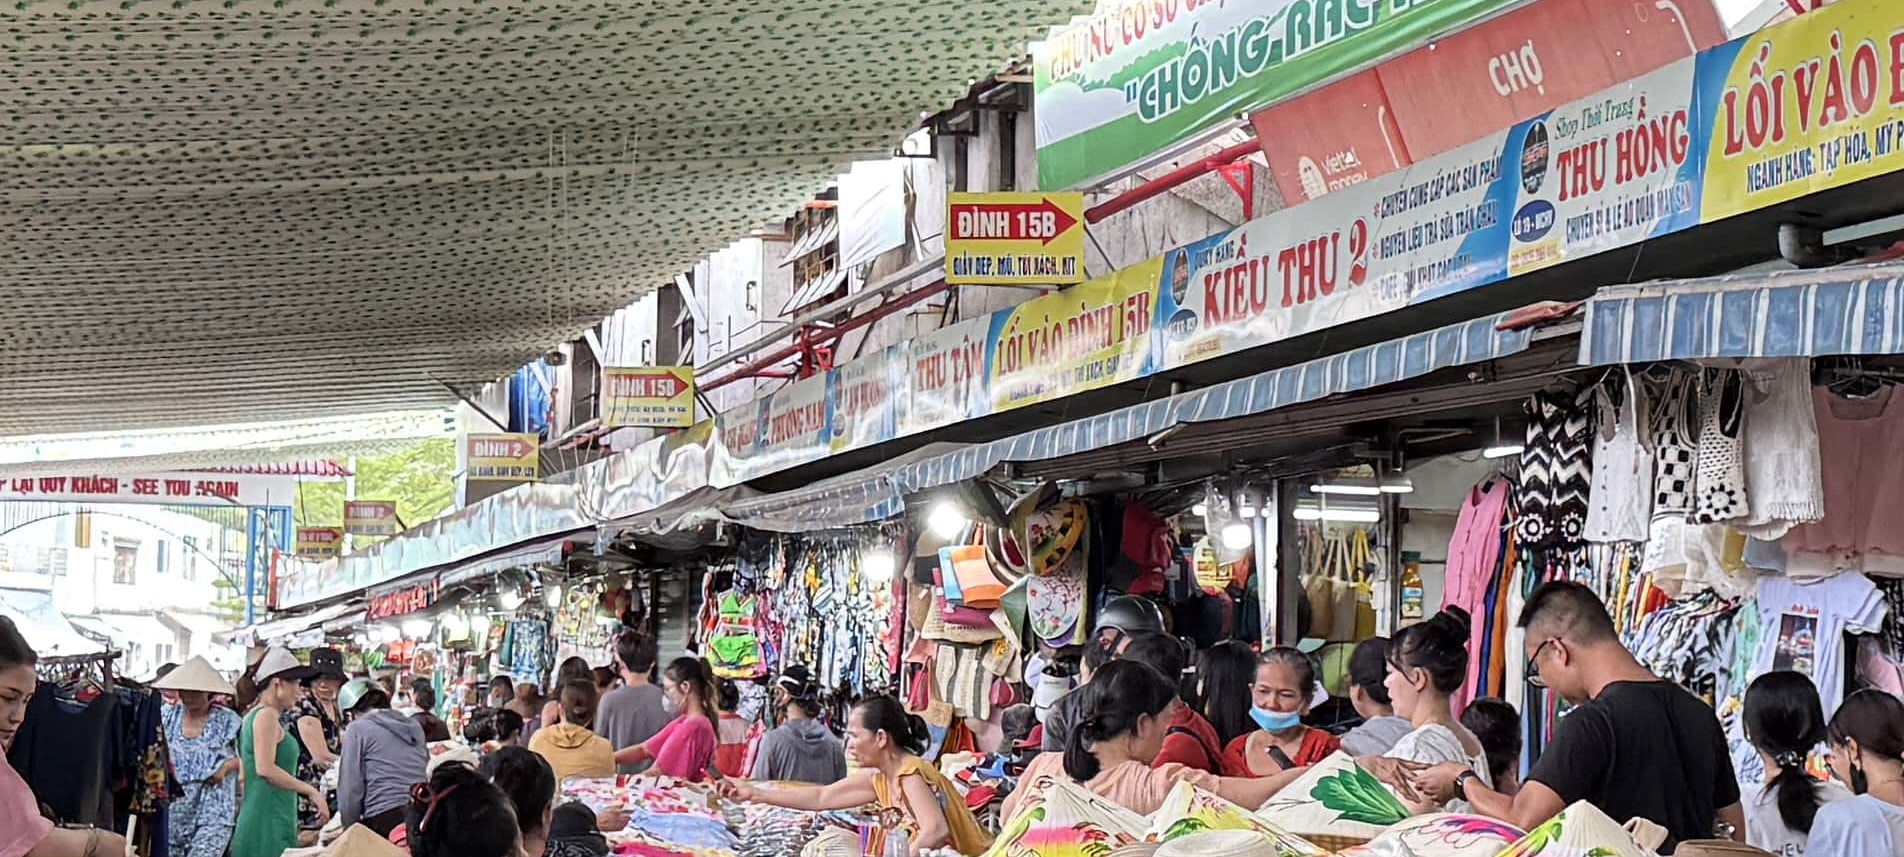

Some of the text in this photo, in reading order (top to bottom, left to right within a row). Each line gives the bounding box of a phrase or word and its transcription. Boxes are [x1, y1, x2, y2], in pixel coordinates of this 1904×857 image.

[1488, 39, 1545, 96] CHỢ
[1723, 44, 1785, 156] LỐI
[1794, 30, 1879, 134] VÀO
[1557, 94, 1689, 202] THU HỒNG
[1819, 136, 1842, 176] TẠP
[958, 206, 1056, 238] ĐÌNH 15B
[1204, 219, 1368, 330] KIỀU THU 2
[916, 349, 947, 393] THU
[12, 478, 34, 494] LẠI
[71, 474, 118, 494] KHÁCH
[132, 478, 159, 495] SEE
[164, 479, 191, 496] YOU
[195, 480, 239, 497] AGAIN
